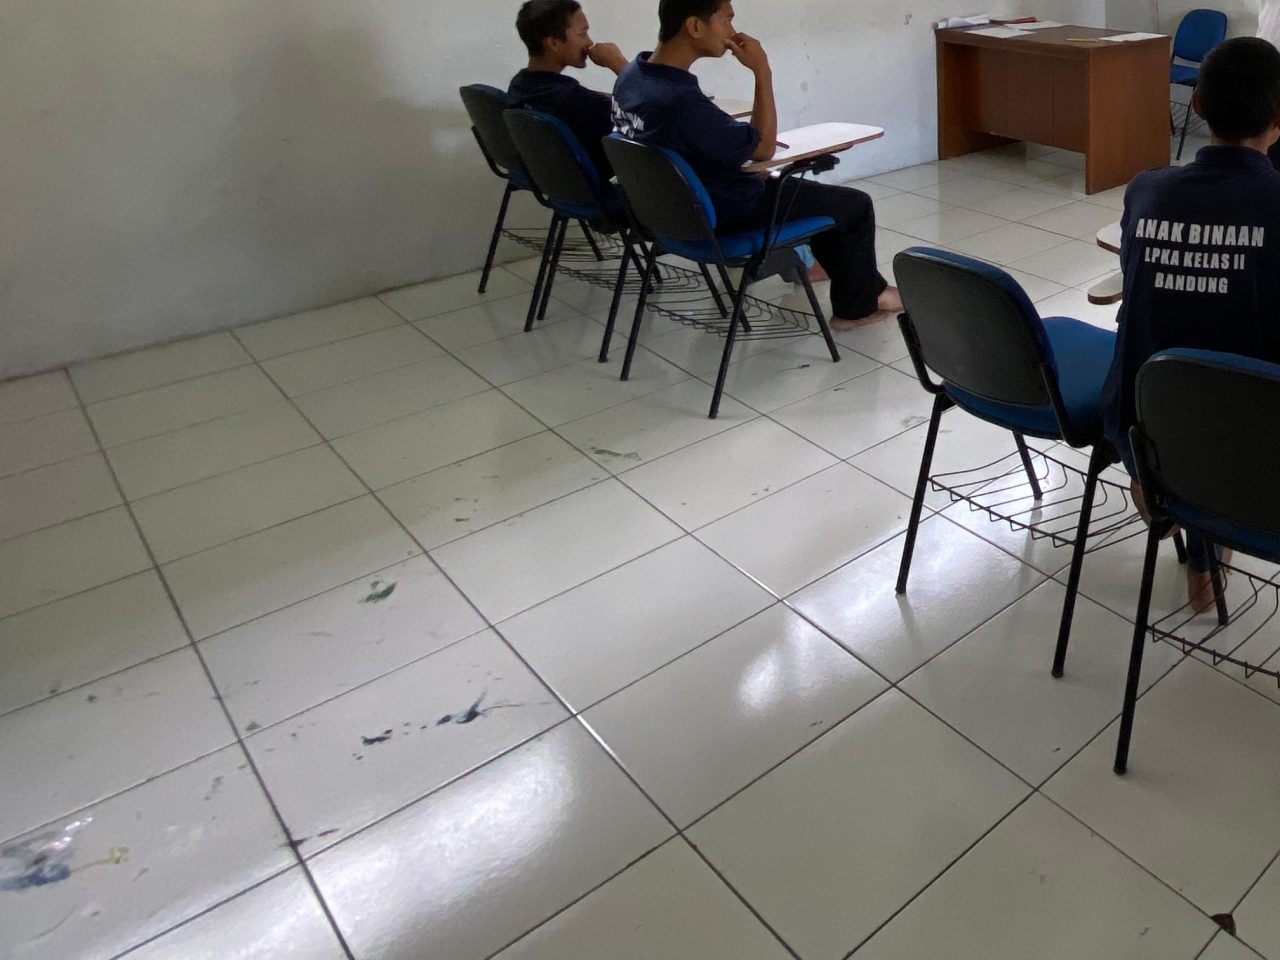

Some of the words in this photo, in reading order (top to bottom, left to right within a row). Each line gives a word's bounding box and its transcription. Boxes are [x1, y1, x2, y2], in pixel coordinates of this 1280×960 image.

[1136, 218, 1184, 242] ANAK
[1188, 224, 1264, 246] BINAAN
[1144, 246, 1179, 266] LPKA
[1183, 251, 1230, 269] KELAS
[1233, 253, 1245, 270] II
[1154, 272, 1228, 294] BANDUNG
